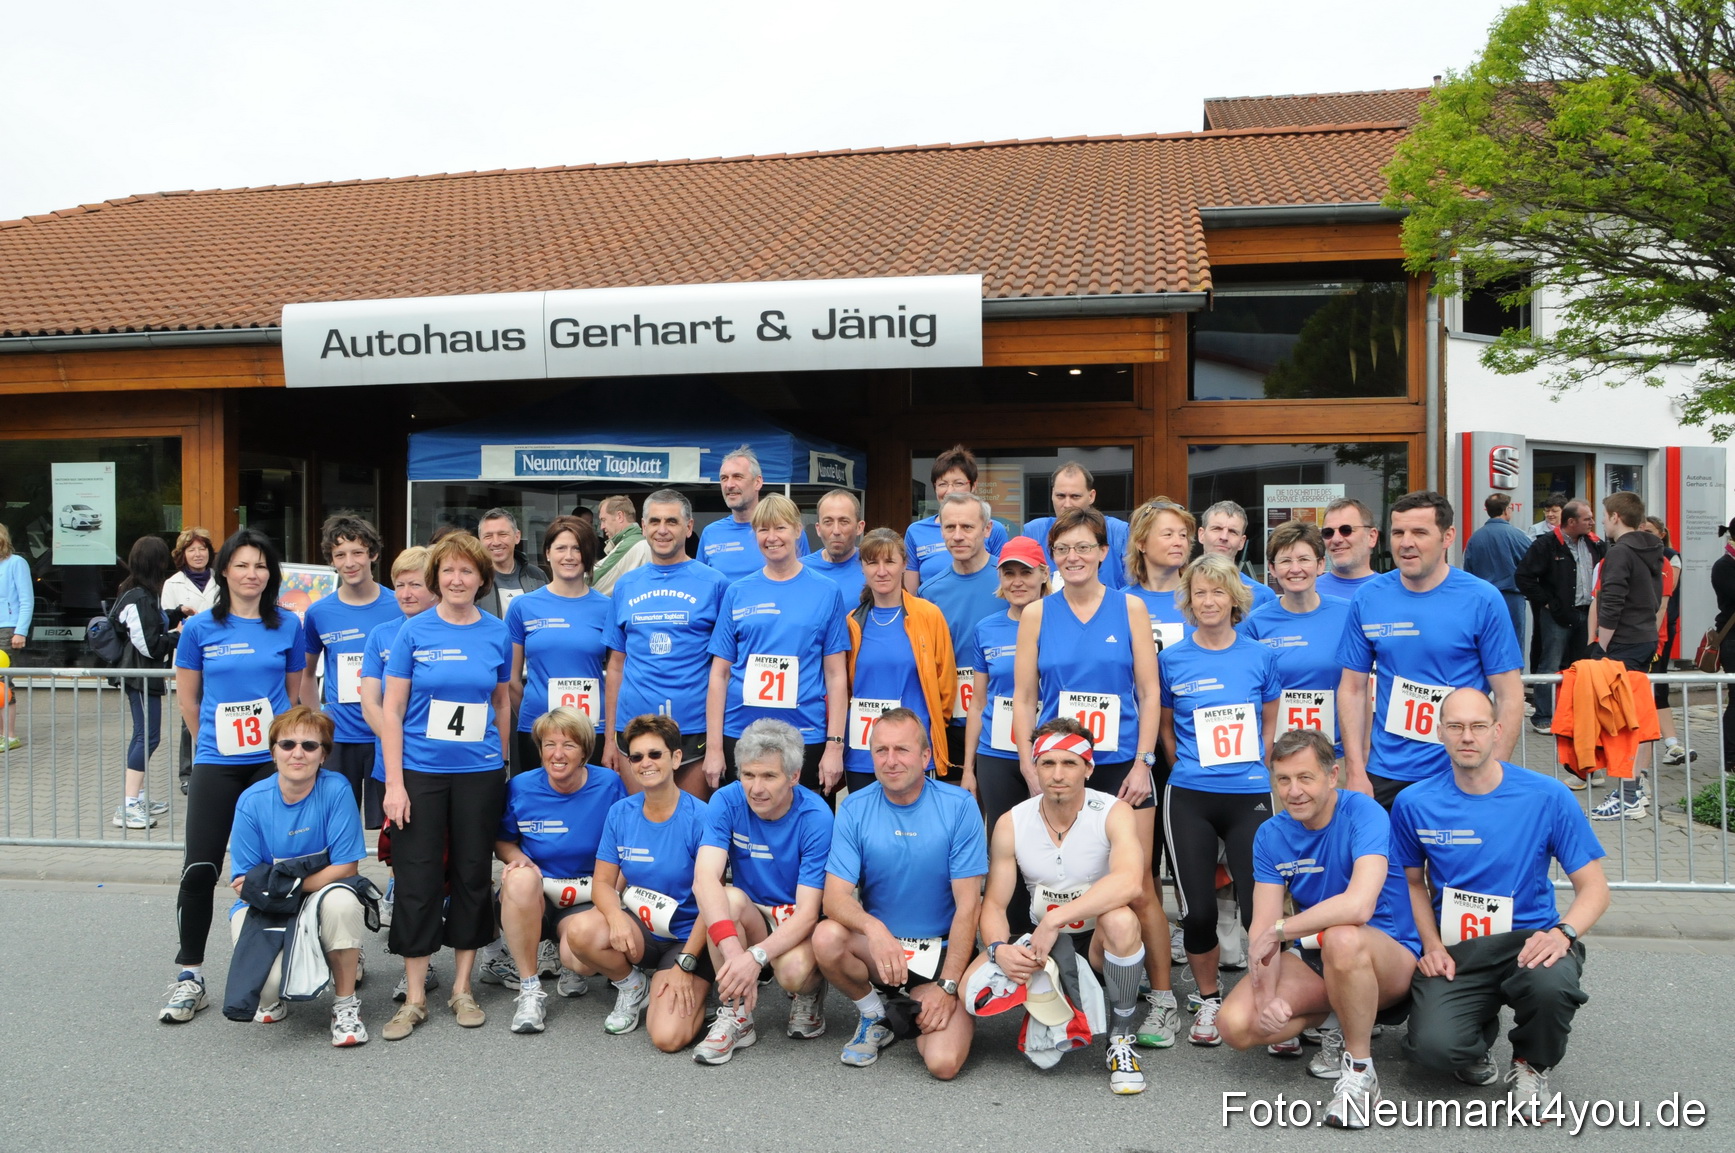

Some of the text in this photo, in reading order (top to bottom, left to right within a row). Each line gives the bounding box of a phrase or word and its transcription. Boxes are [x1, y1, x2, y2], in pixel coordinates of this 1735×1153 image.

[321, 305, 937, 358] Autohaus Gerhart & Jänig
[522, 454, 662, 474] Neumarkter Tagblatt
[628, 589, 697, 607] funrunners
[755, 656, 779, 664] MEYER
[758, 670, 785, 702] 21
[1401, 688, 1429, 700] WERBUNG
[1402, 682, 1430, 696] MEYER
[224, 704, 251, 713] MEYER
[1069, 694, 1098, 703] MEYER
[447, 705, 465, 737] 4
[1204, 708, 1233, 718] MEYER
[1288, 706, 1322, 732] 55
[1404, 699, 1435, 735] 16
[232, 716, 263, 748] 13
[1076, 710, 1106, 744] 10
[1213, 723, 1244, 759] 67
[558, 886, 577, 908] 9
[634, 887, 658, 901] MEYER
[1042, 889, 1069, 899] MEYER
[1453, 891, 1485, 904] MEYER
[1453, 899, 1485, 911] WERBUNG
[638, 905, 655, 932] 8
[1460, 912, 1491, 941] 61
